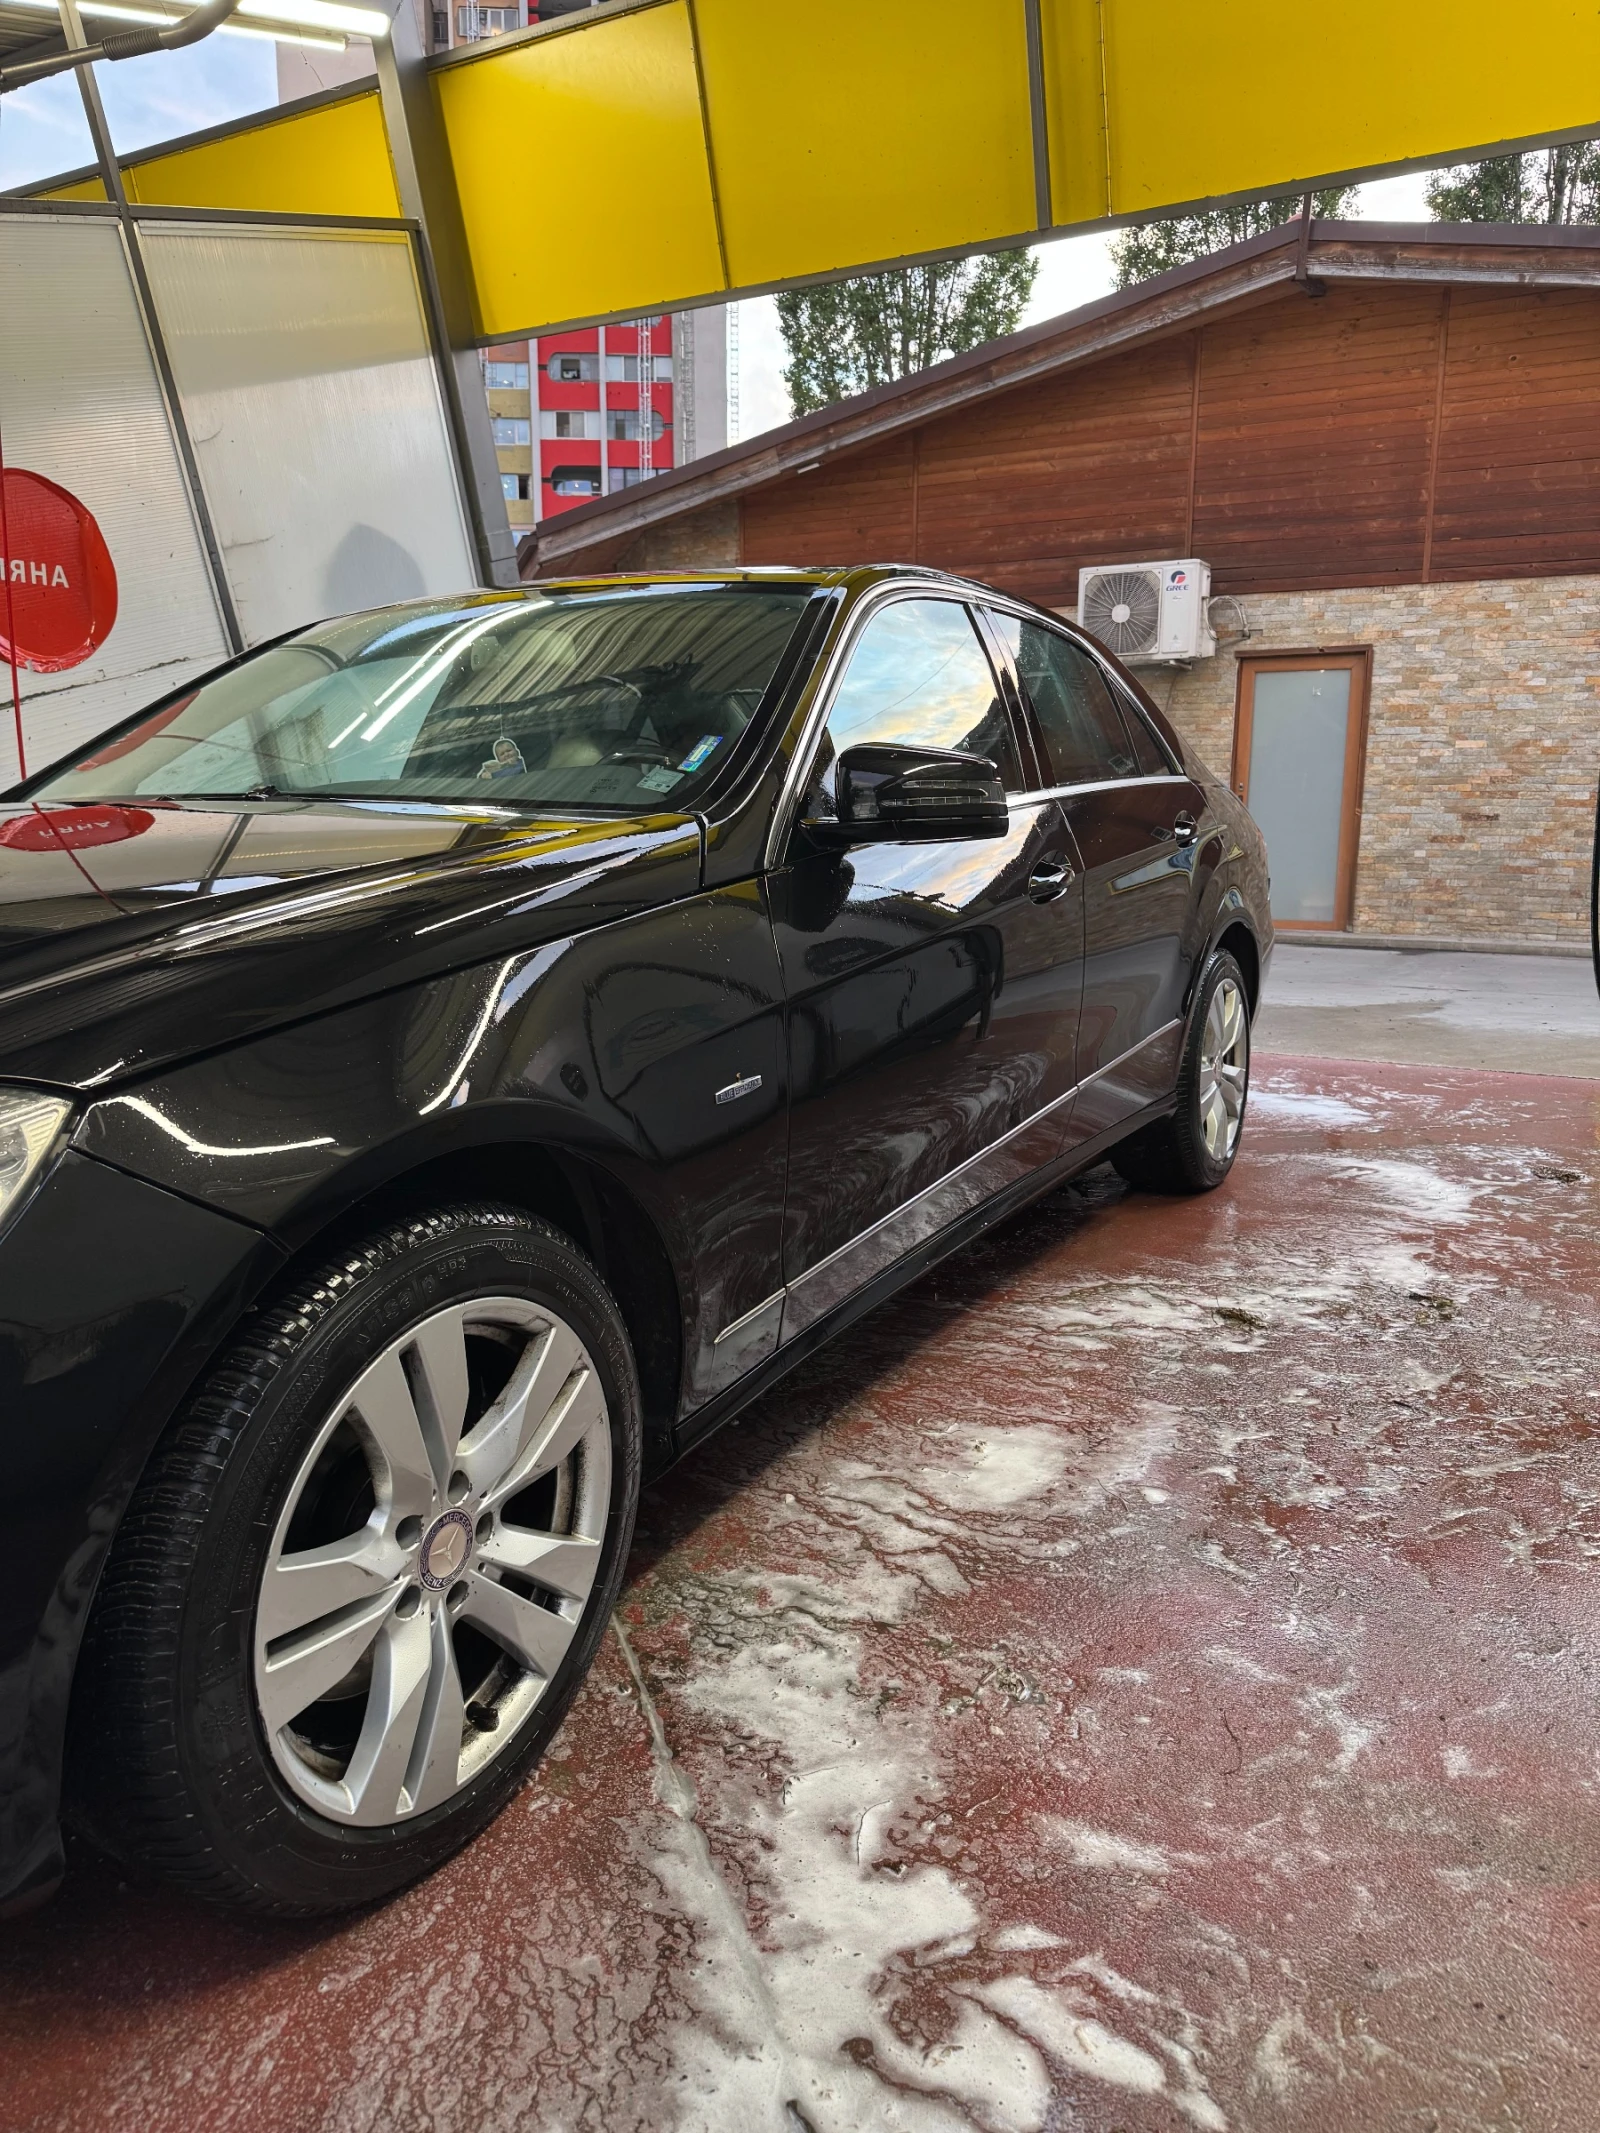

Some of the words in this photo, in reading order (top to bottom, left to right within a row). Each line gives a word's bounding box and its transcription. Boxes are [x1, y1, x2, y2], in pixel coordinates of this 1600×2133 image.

[1166, 584, 1190, 592] GREE
[442, 1512, 473, 1541] MERCEDES
[424, 1573, 443, 1588] BENZ
